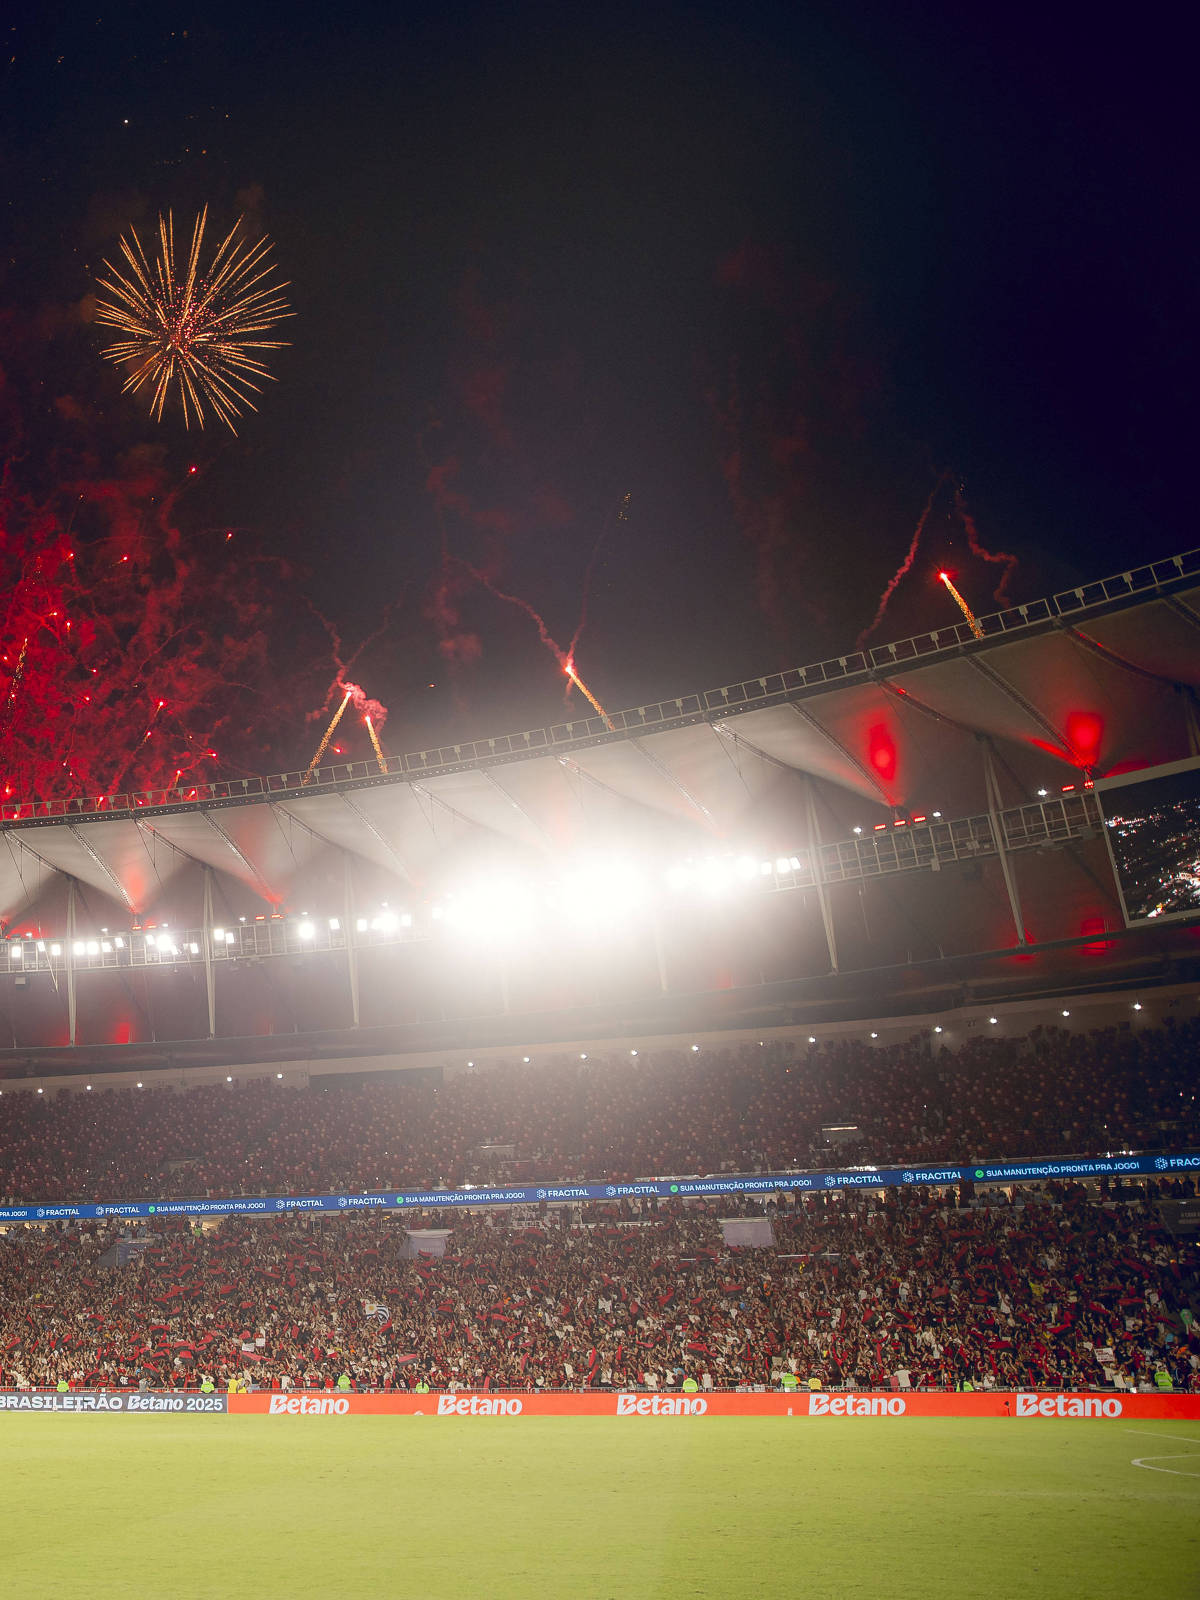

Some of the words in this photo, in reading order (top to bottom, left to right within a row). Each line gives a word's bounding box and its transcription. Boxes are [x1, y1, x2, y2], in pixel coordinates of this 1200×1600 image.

[1170, 1157, 1200, 1167] FRAC
[986, 1169, 1002, 1177] SUA
[1003, 1166, 1059, 1176] MANUTENÇÃO
[1061, 1164, 1094, 1173] PRONTA
[1095, 1163, 1112, 1171] PRA
[1113, 1162, 1139, 1170] JOGO!
[837, 1175, 882, 1185] FRACTTAL
[618, 1185, 659, 1194] FRACTTAL
[680, 1184, 694, 1192] SUA
[696, 1182, 744, 1191] MANUTENÇÃO
[746, 1181, 773, 1189] PRONTA
[774, 1180, 788, 1188] PRA
[790, 1179, 811, 1187] JOGO!
[420, 1193, 463, 1203] MANUTENÇÃO
[464, 1193, 490, 1201] PRONTA
[491, 1192, 503, 1200] PRA
[548, 1189, 589, 1197] FRACTTAL
[286, 1199, 323, 1208] FRACTTAL
[349, 1197, 386, 1205] FRACTTAL
[46, 1208, 79, 1216] FRACTTAL
[105, 1206, 139, 1214] FRACTTAL
[170, 1204, 209, 1212] MANUTENÇÃO
[210, 1203, 233, 1211] PRONTA
[127, 1395, 184, 1411] Betano
[186, 1398, 223, 1411] 2025
[269, 1395, 349, 1415] Betano
[437, 1395, 523, 1415] Betano
[616, 1394, 707, 1415] Betano
[808, 1394, 906, 1416] Betano
[1016, 1394, 1122, 1417] Betano
